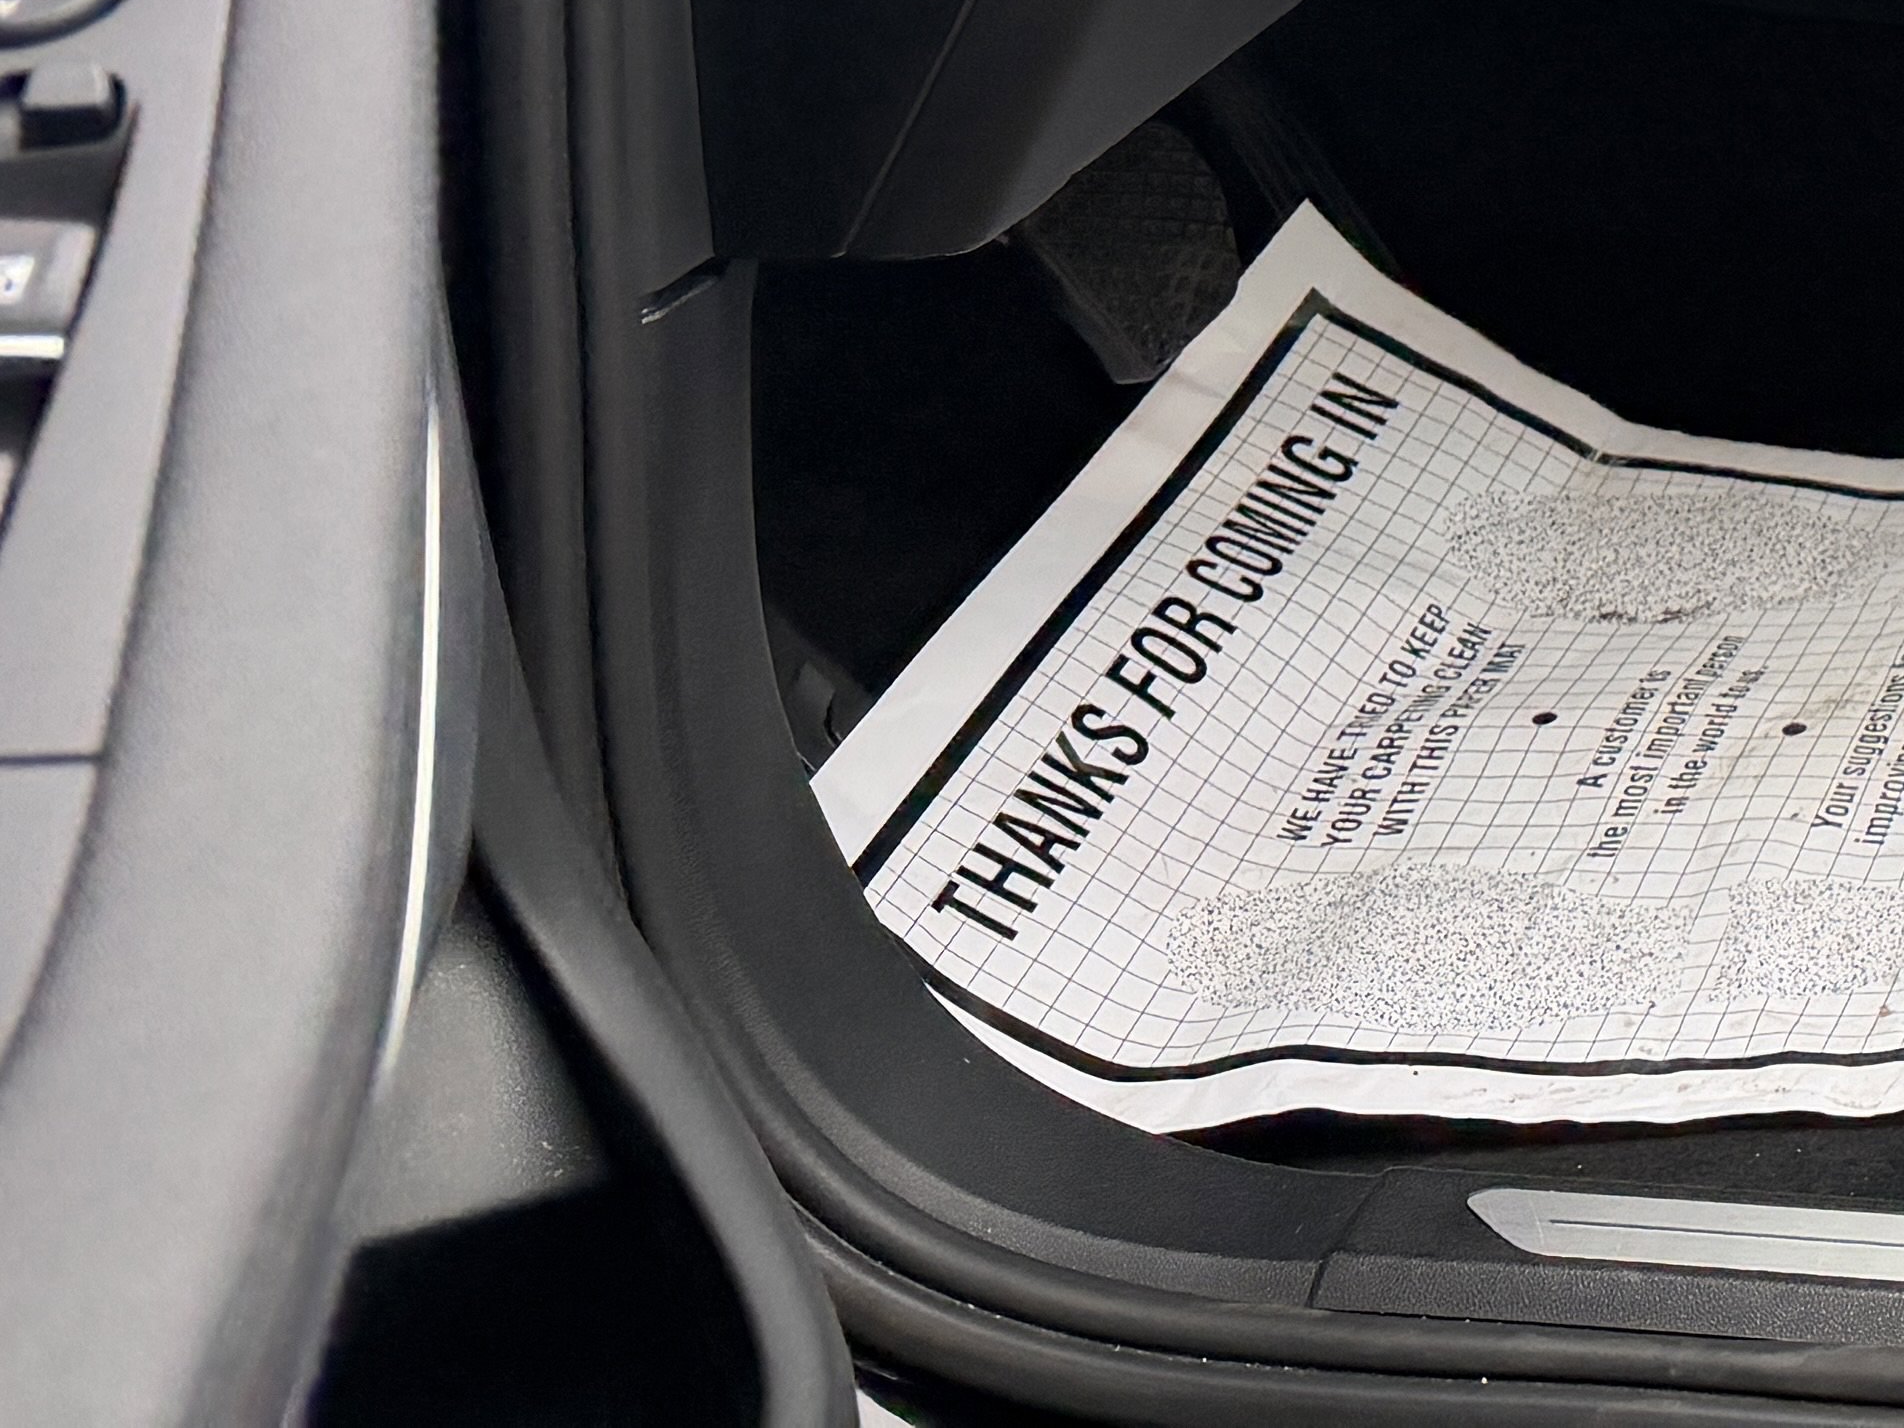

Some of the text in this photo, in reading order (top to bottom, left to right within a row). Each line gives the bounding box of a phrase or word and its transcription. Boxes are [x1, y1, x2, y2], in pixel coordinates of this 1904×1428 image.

[931, 372, 1399, 941] THANKS FOR COMING IN
[1720, 684, 1750, 699] to
[1276, 603, 1450, 841] WE HAVE TRIED TO KEEP
[1321, 788, 1381, 847] YOUR
[1434, 622, 1492, 680] CLEAN
[1577, 774, 1607, 787] A
[1593, 684, 1659, 766] customer
[1587, 636, 1745, 858] the most important person
[1693, 704, 1738, 755] world
[1373, 781, 1430, 836] WITH
[1409, 724, 1459, 771] THIS
[1653, 796, 1689, 814] in
[1668, 759, 1707, 790] the
[1811, 782, 1859, 828] Your
